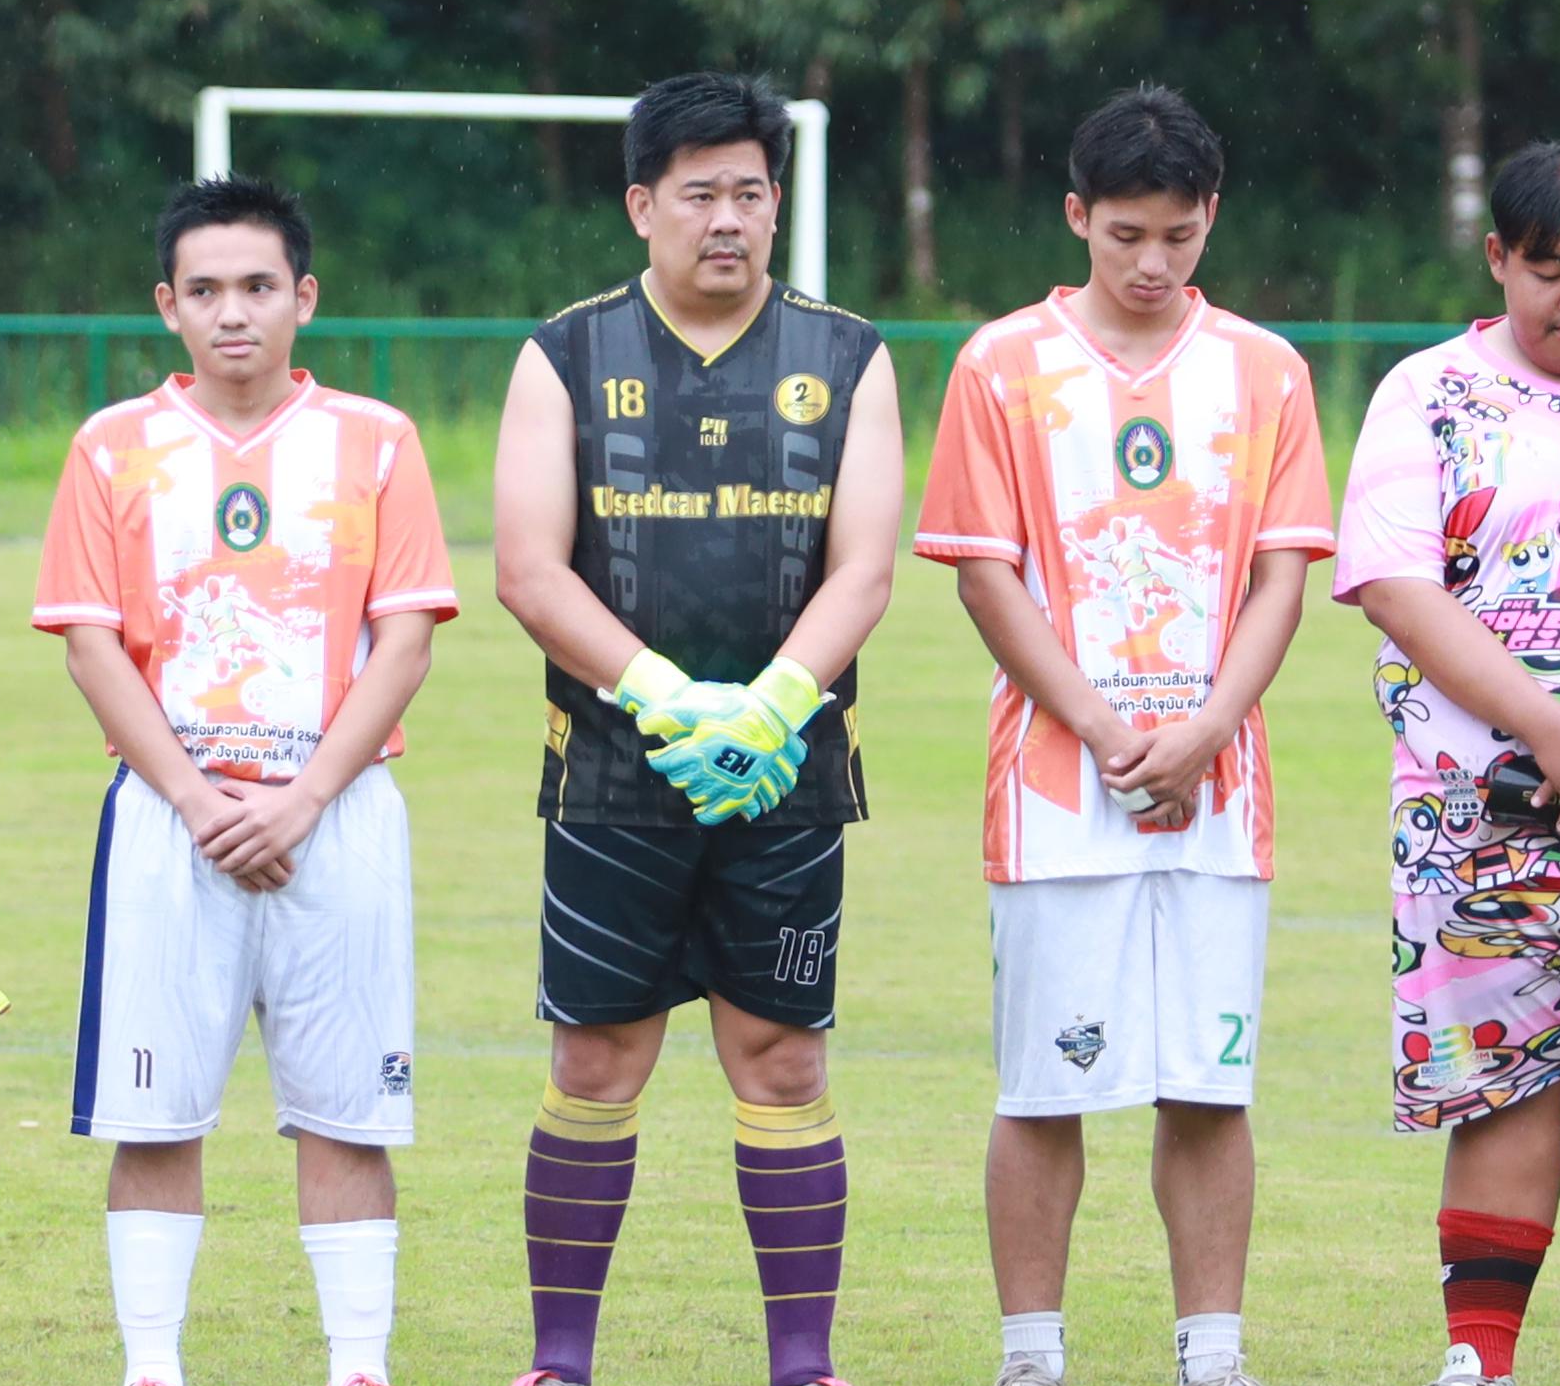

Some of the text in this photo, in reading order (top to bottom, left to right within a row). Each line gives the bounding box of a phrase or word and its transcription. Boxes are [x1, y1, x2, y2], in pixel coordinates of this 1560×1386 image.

[601, 377, 647, 420] 18
[1452, 431, 1513, 494] 27
[592, 483, 832, 519] Usedcar Maesod
[774, 926, 826, 986] 18
[132, 1047, 153, 1089] 11
